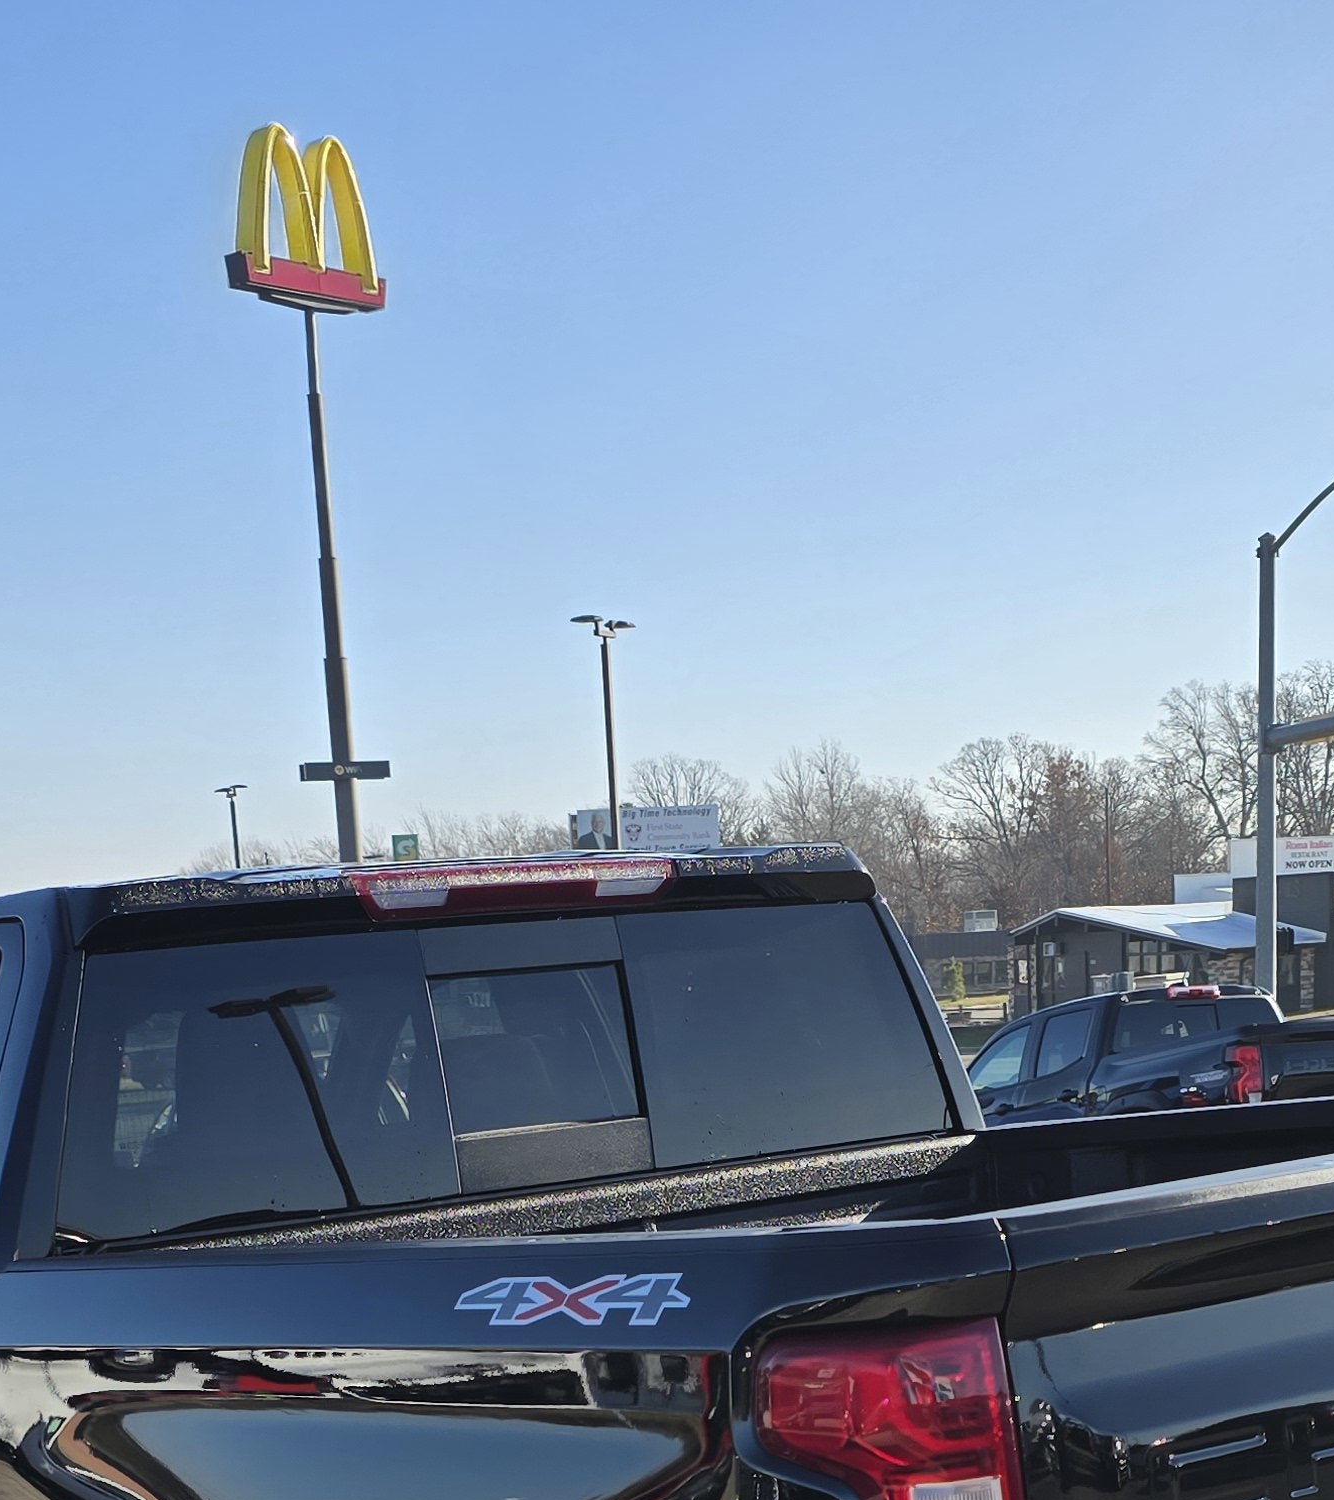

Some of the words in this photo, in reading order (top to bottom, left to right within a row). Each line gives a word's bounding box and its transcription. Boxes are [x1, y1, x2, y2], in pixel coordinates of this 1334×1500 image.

[622, 809, 636, 819] Big
[639, 809, 660, 818] Time
[663, 807, 711, 817] Technology
[1286, 861, 1307, 869] NOW
[1308, 860, 1333, 868] OPEN
